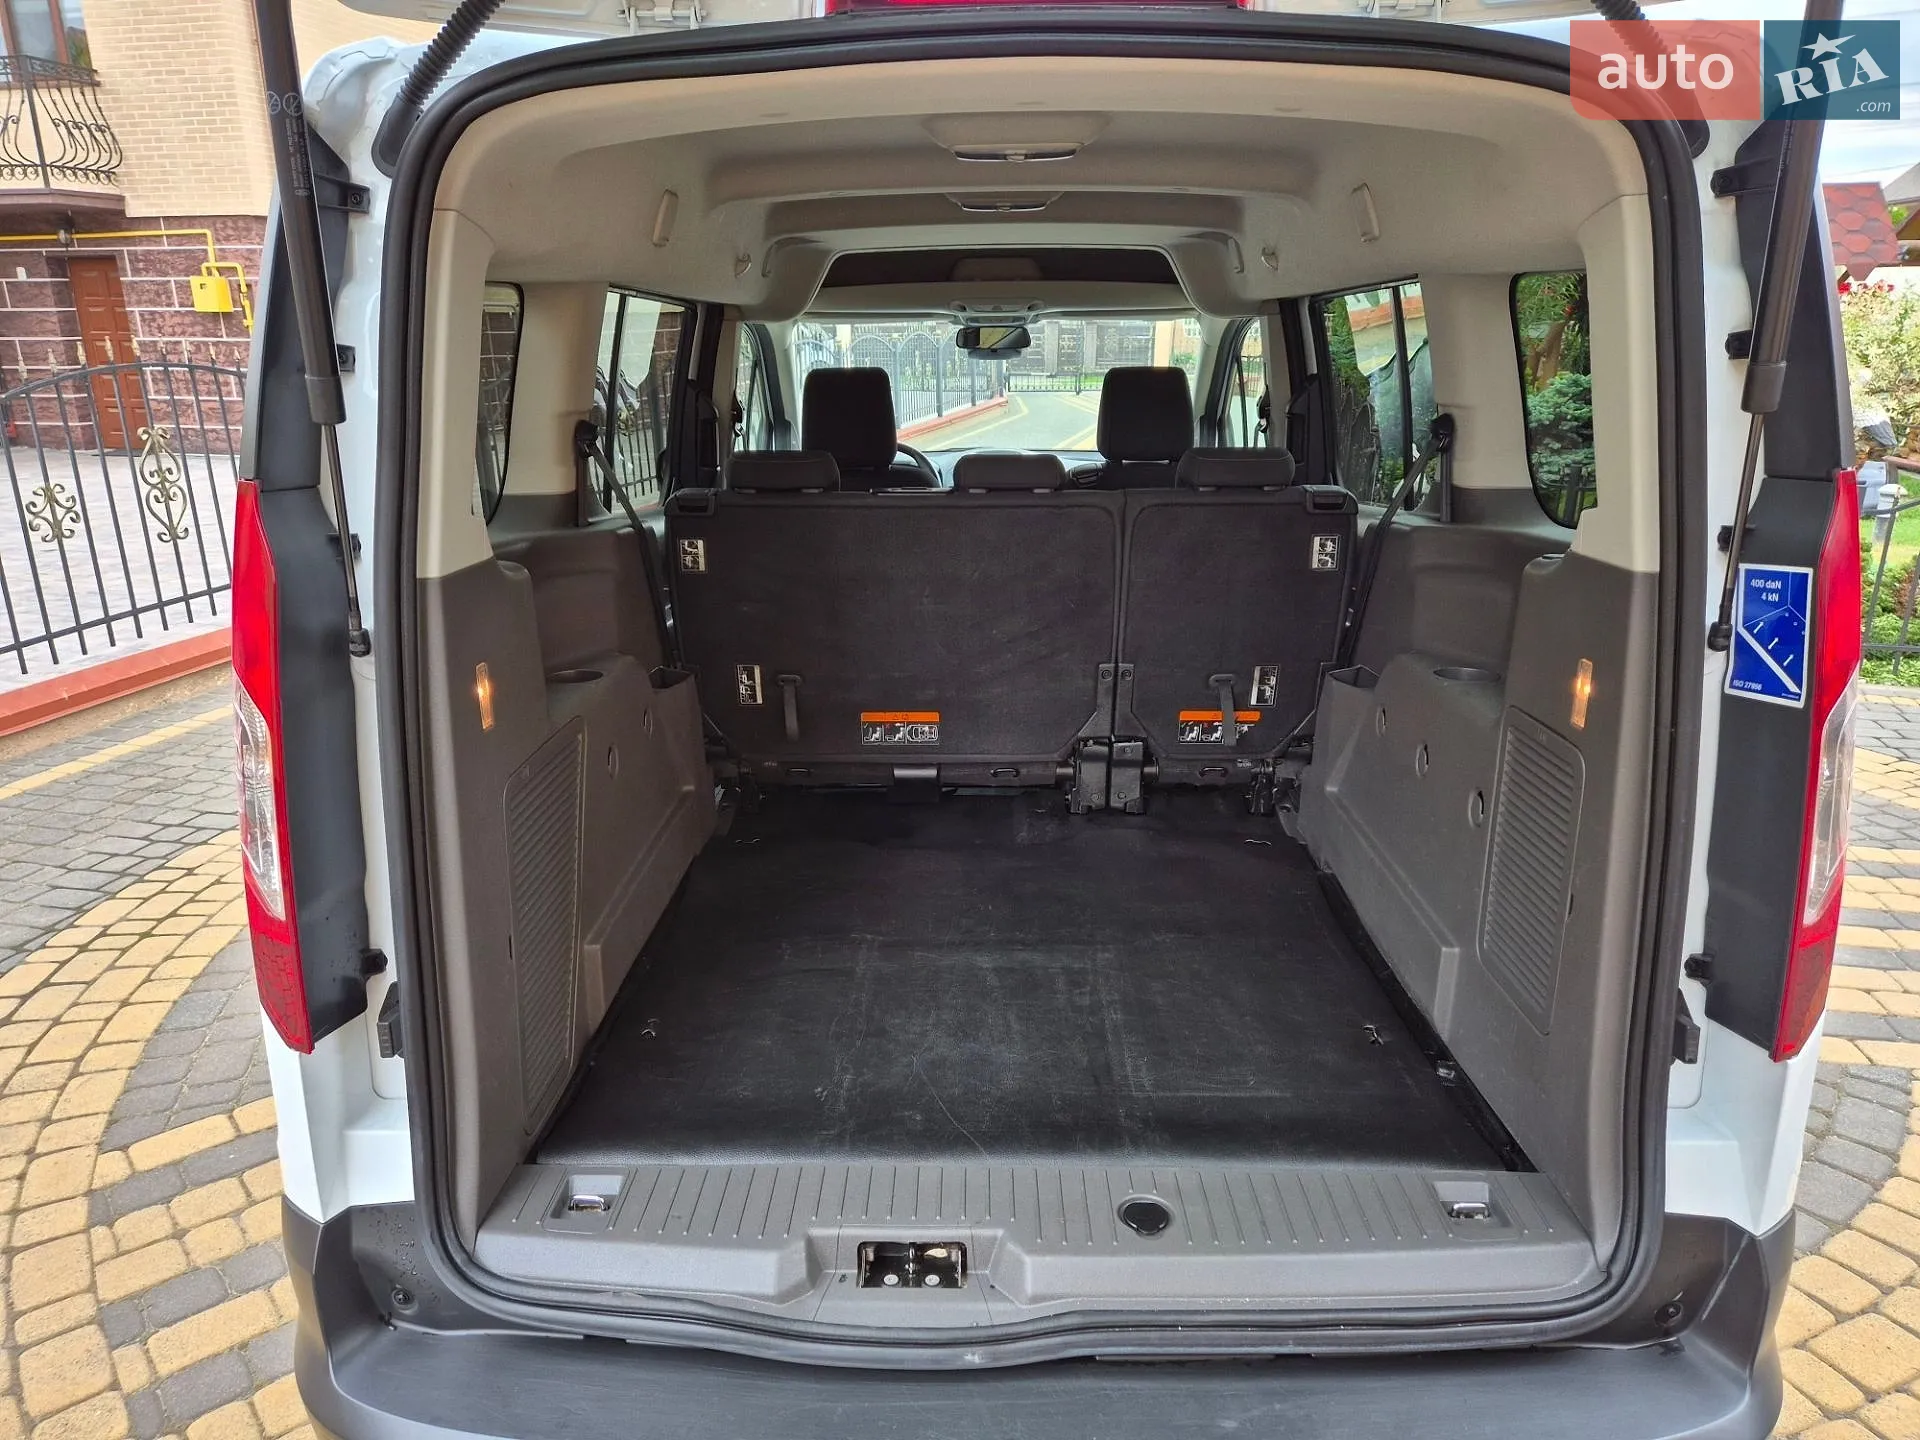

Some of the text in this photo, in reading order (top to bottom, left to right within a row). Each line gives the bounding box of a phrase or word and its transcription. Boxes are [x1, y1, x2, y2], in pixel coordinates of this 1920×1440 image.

[1750, 578, 1782, 589] 400 daN
[1761, 592, 1779, 602] 4 kN
[1732, 679, 1744, 687] ISO
